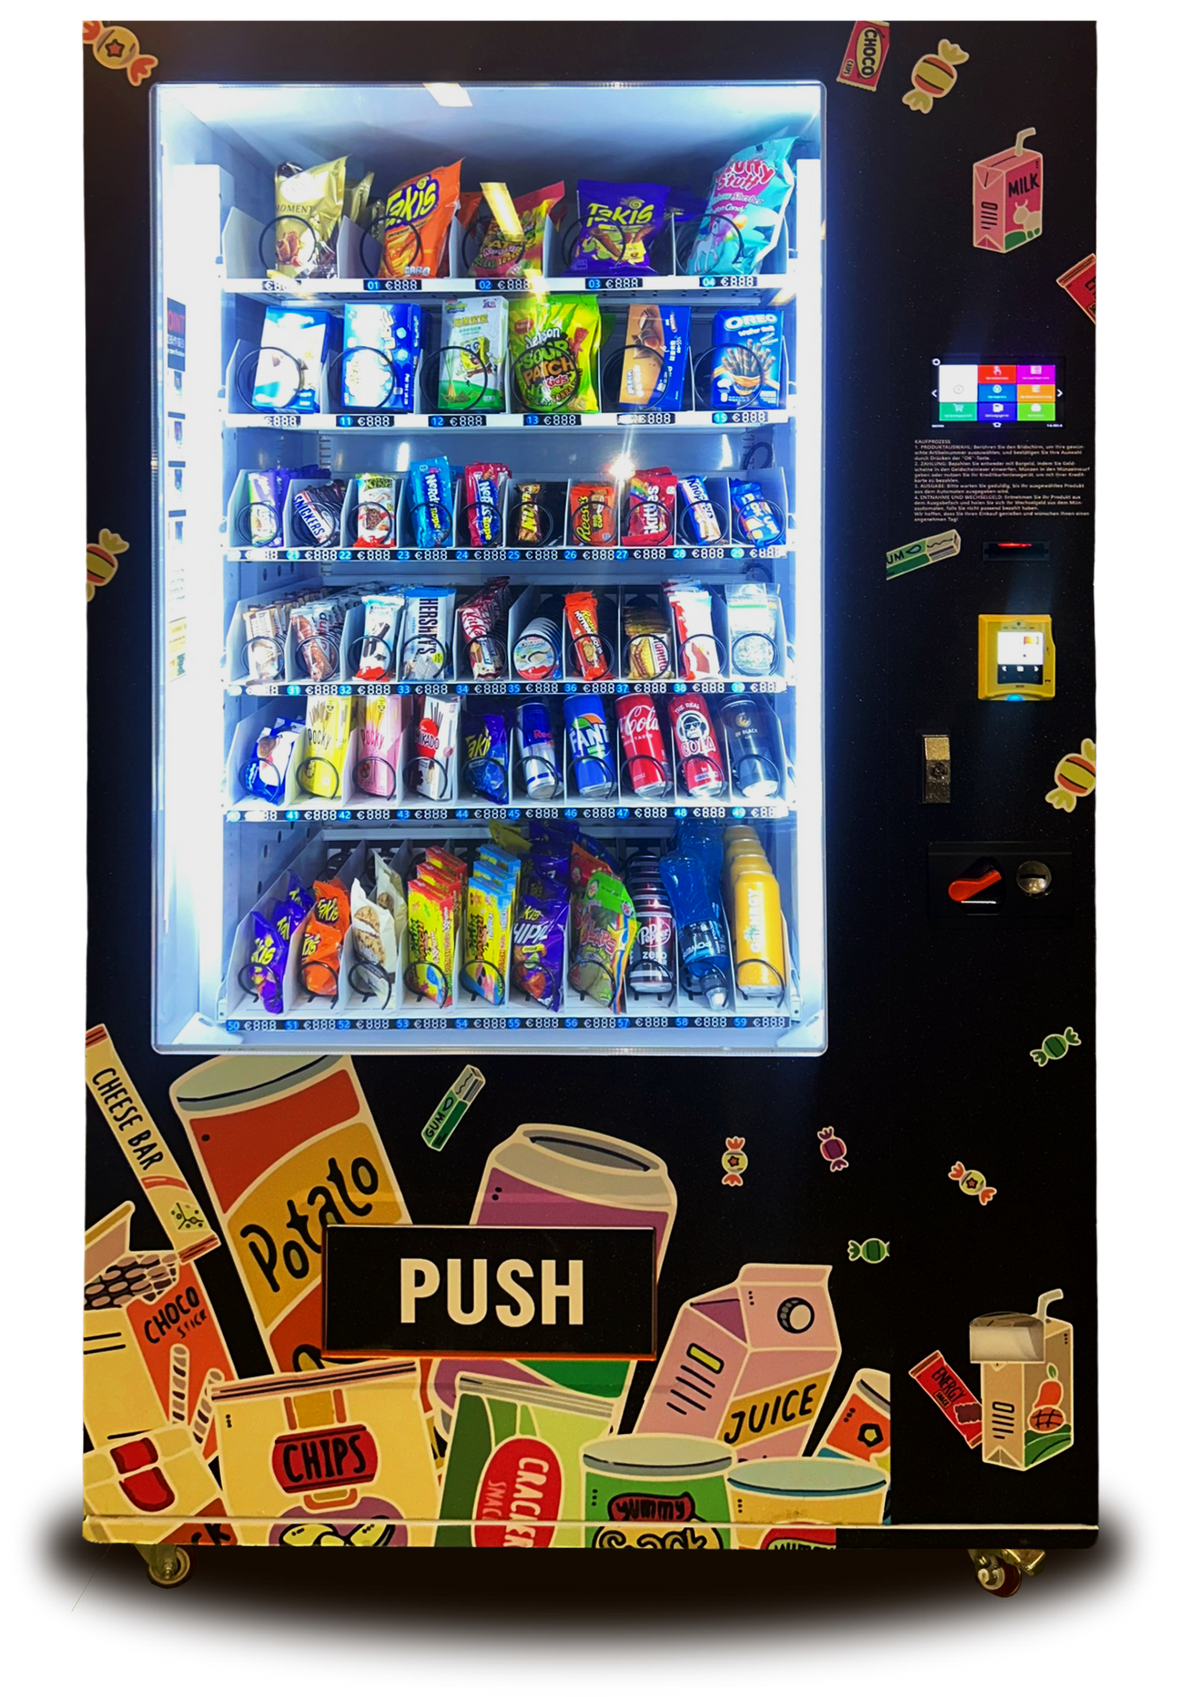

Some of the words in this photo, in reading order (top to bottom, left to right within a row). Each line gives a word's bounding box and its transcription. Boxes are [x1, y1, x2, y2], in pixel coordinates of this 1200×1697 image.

[861, 29, 877, 76] CHOCO
[1008, 172, 1040, 198] MILK
[586, 198, 656, 228] Takis
[724, 314, 778, 332] OREO
[523, 357, 575, 386] PATCH
[293, 494, 325, 537] SNICKERS
[308, 729, 331, 750] POCKY
[361, 729, 384, 750] POCKY
[681, 735, 717, 757] COLA
[92, 1067, 143, 1132] CHEESE
[127, 1129, 165, 1171] BAR
[425, 1112, 446, 1138] GUM
[240, 1156, 379, 1293] Potato
[400, 1258, 584, 1328] PUSH
[144, 1286, 201, 1344] CHOCO
[176, 1308, 208, 1340] STICK
[931, 1366, 968, 1402] ENERGY
[724, 1383, 817, 1444] JUICE
[283, 1434, 366, 1483] CHIPS
[615, 1498, 686, 1521] yummy
